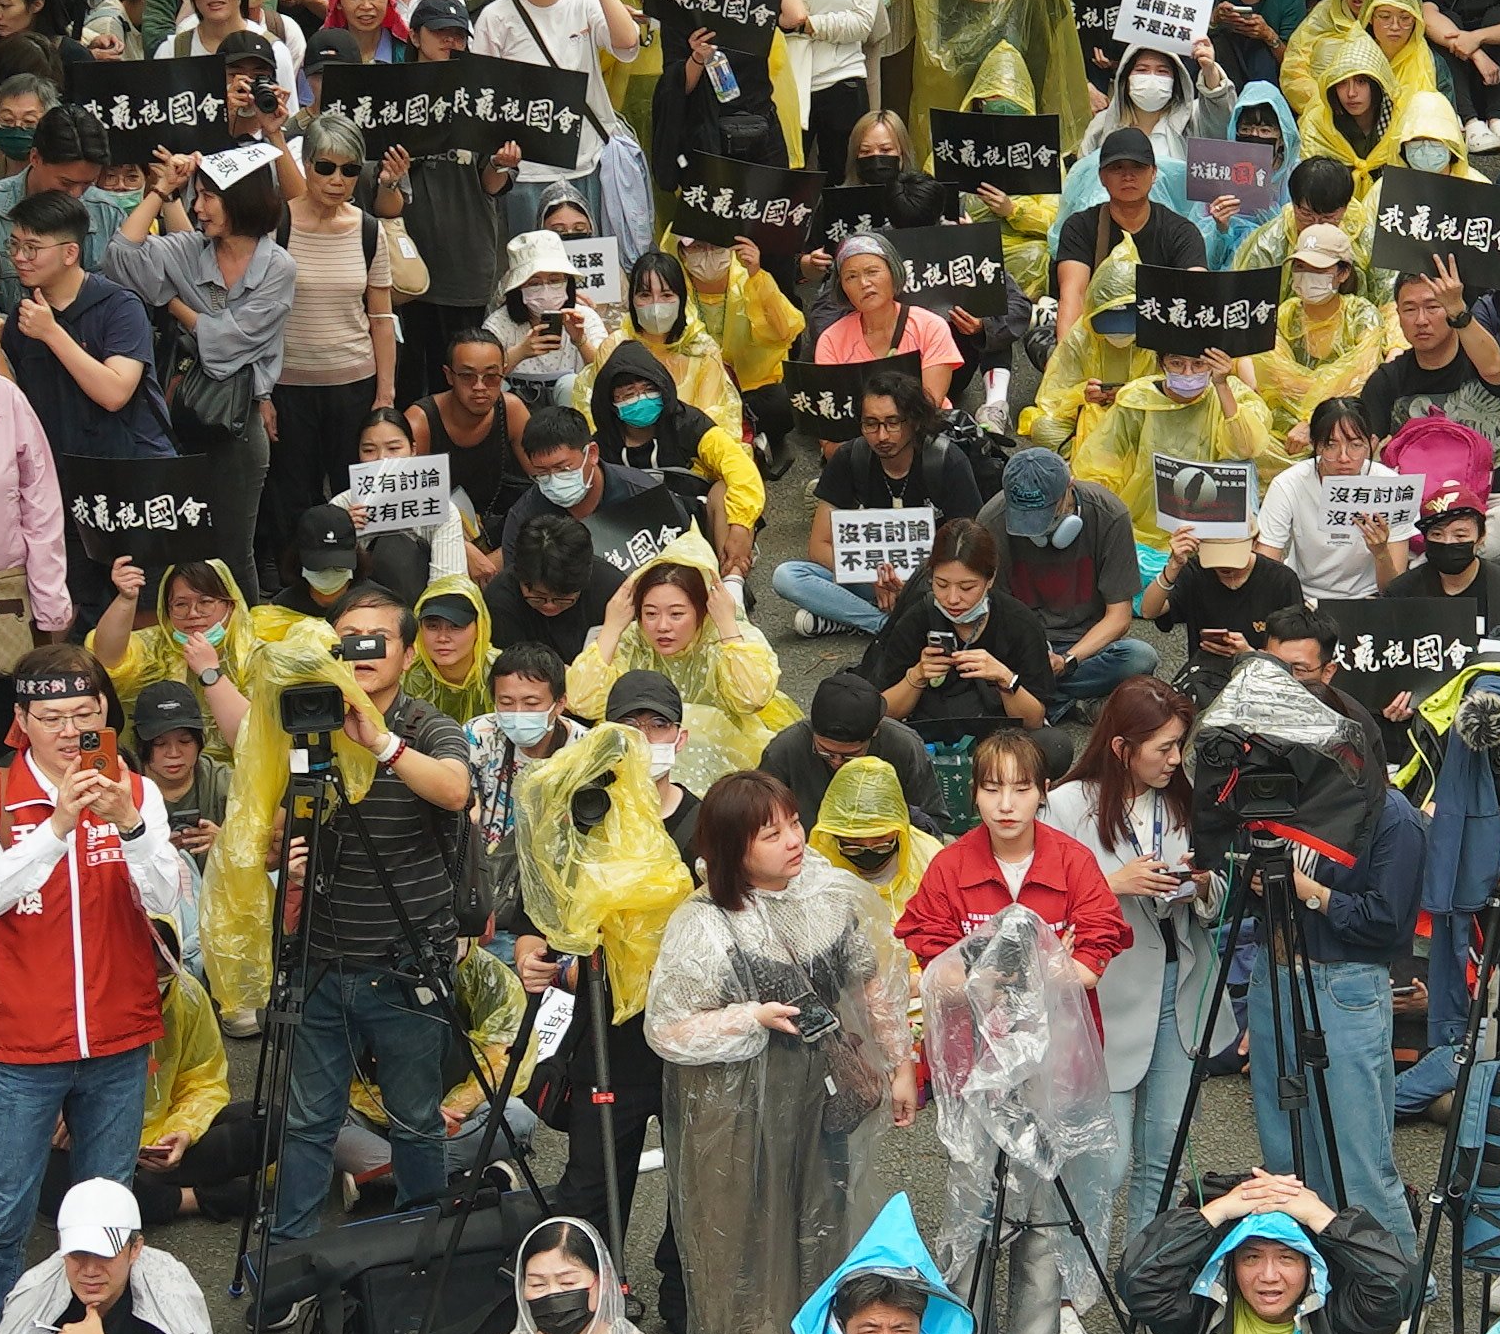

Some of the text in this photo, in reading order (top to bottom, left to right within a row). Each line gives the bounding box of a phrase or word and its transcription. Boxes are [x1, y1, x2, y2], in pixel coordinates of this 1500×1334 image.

[1132, 16, 1191, 41] 不是改革
[324, 93, 451, 128] 我藐視國會
[453, 87, 580, 133] 我藐視國會
[934, 140, 1057, 169] 我藐視國會
[683, 185, 812, 226] 我藐視國會
[1137, 297, 1275, 329] 我藐視國會
[1330, 485, 1414, 503] 沒有討論
[839, 520, 930, 543] 沒有討論
[840, 544, 932, 572] 不是民主
